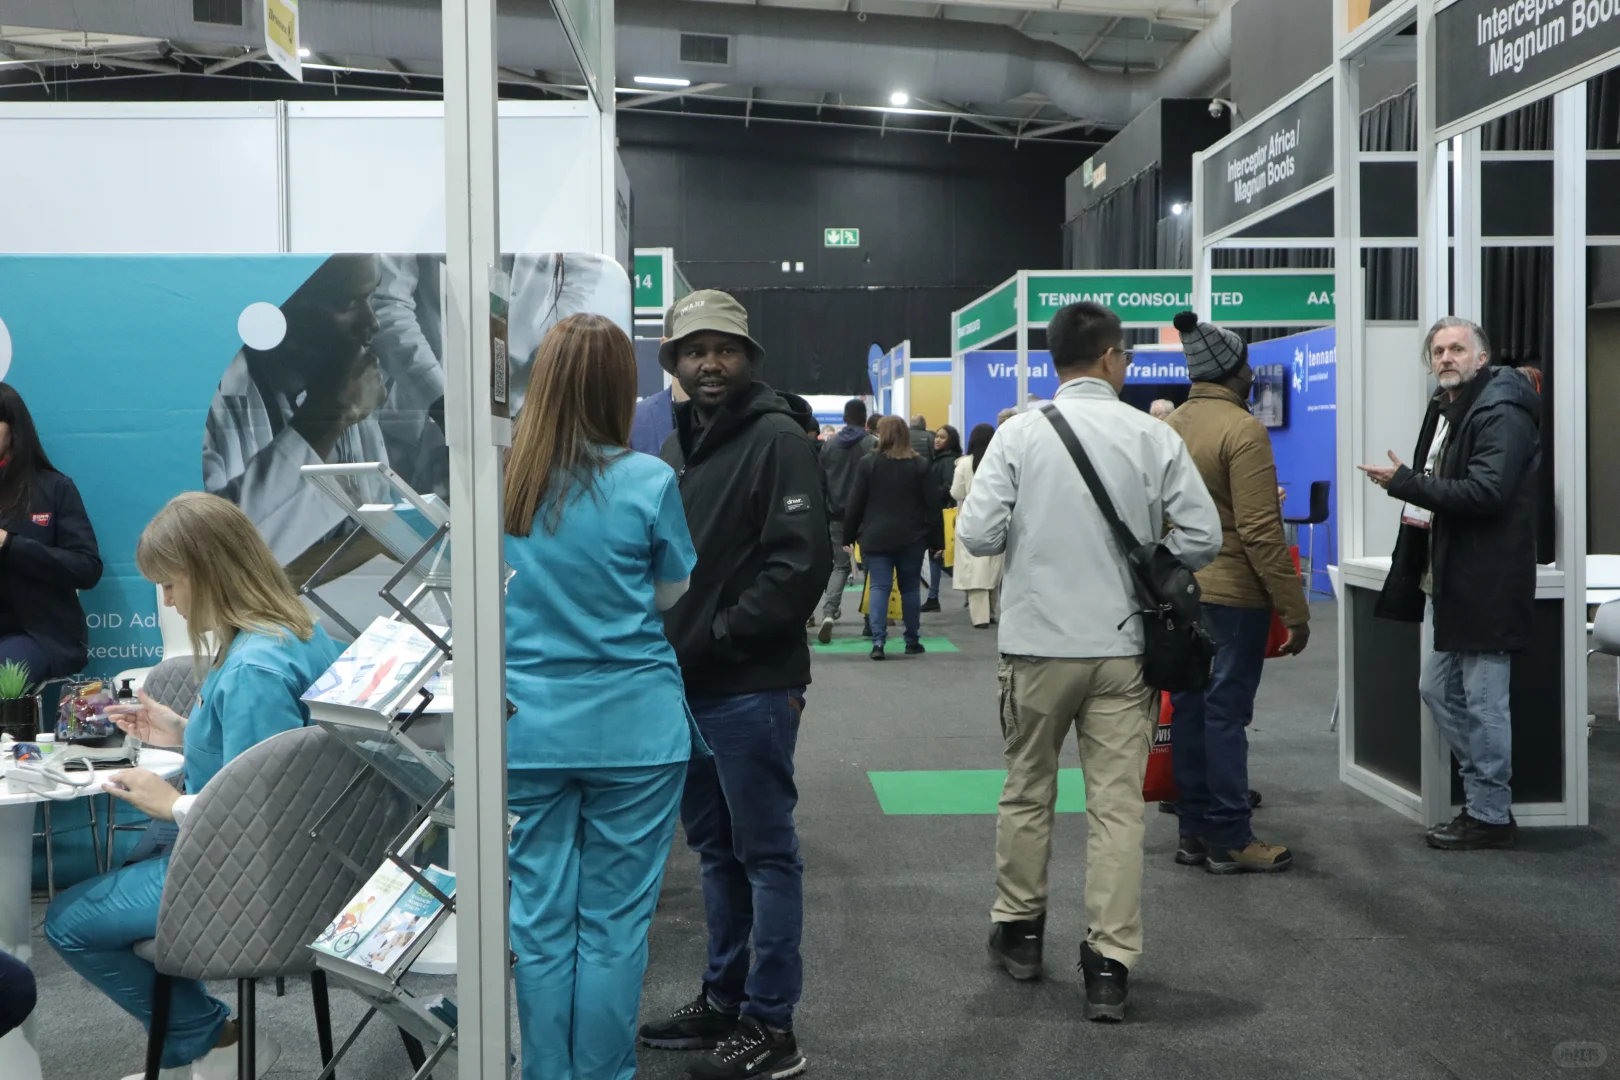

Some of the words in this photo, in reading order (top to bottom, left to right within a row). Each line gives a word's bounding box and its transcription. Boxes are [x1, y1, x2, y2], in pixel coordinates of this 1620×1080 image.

[1489, 15, 1565, 76] Magnum
[1227, 144, 1268, 183] Interceptor
[1234, 171, 1267, 203] Magnum
[1267, 154, 1295, 186] Boots
[1118, 292, 1243, 306] CONSOLITED
